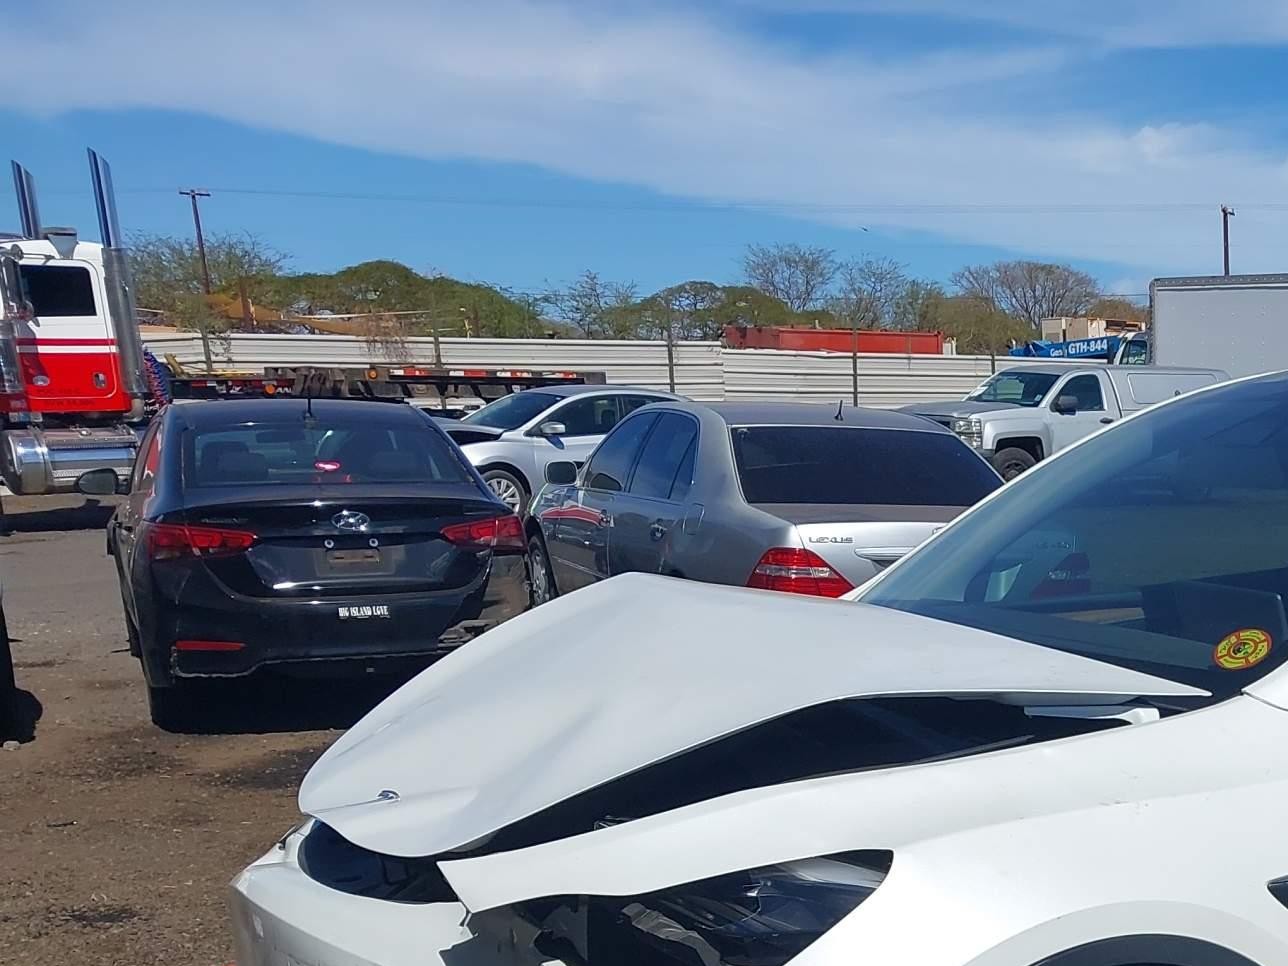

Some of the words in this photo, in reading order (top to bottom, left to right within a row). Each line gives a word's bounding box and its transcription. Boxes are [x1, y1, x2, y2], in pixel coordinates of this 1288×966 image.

[1068, 339, 1108, 354] GTH-844
[1050, 348, 1068, 358] Gen
[350, 606, 373, 617] ISLAND
